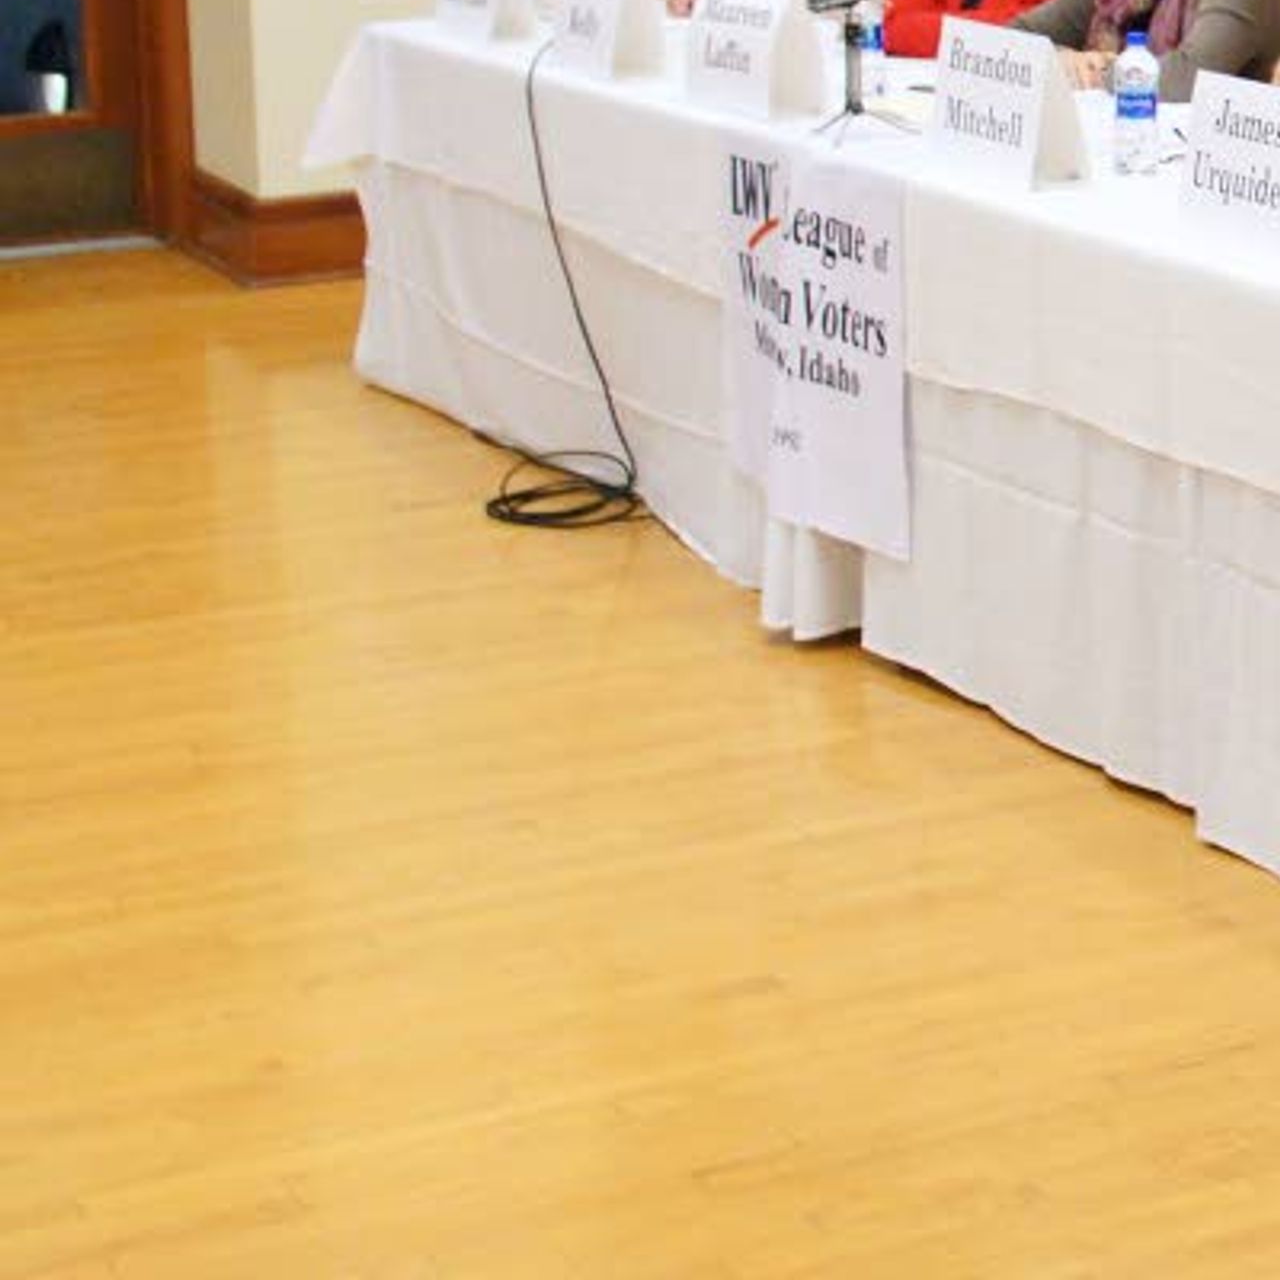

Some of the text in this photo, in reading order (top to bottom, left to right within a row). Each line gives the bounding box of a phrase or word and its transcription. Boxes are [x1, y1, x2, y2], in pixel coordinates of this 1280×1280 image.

[949, 37, 1032, 88] Brandon
[947, 97, 1024, 149] Mitchell
[803, 281, 888, 358] Voters
[800, 345, 861, 399] Idaho
